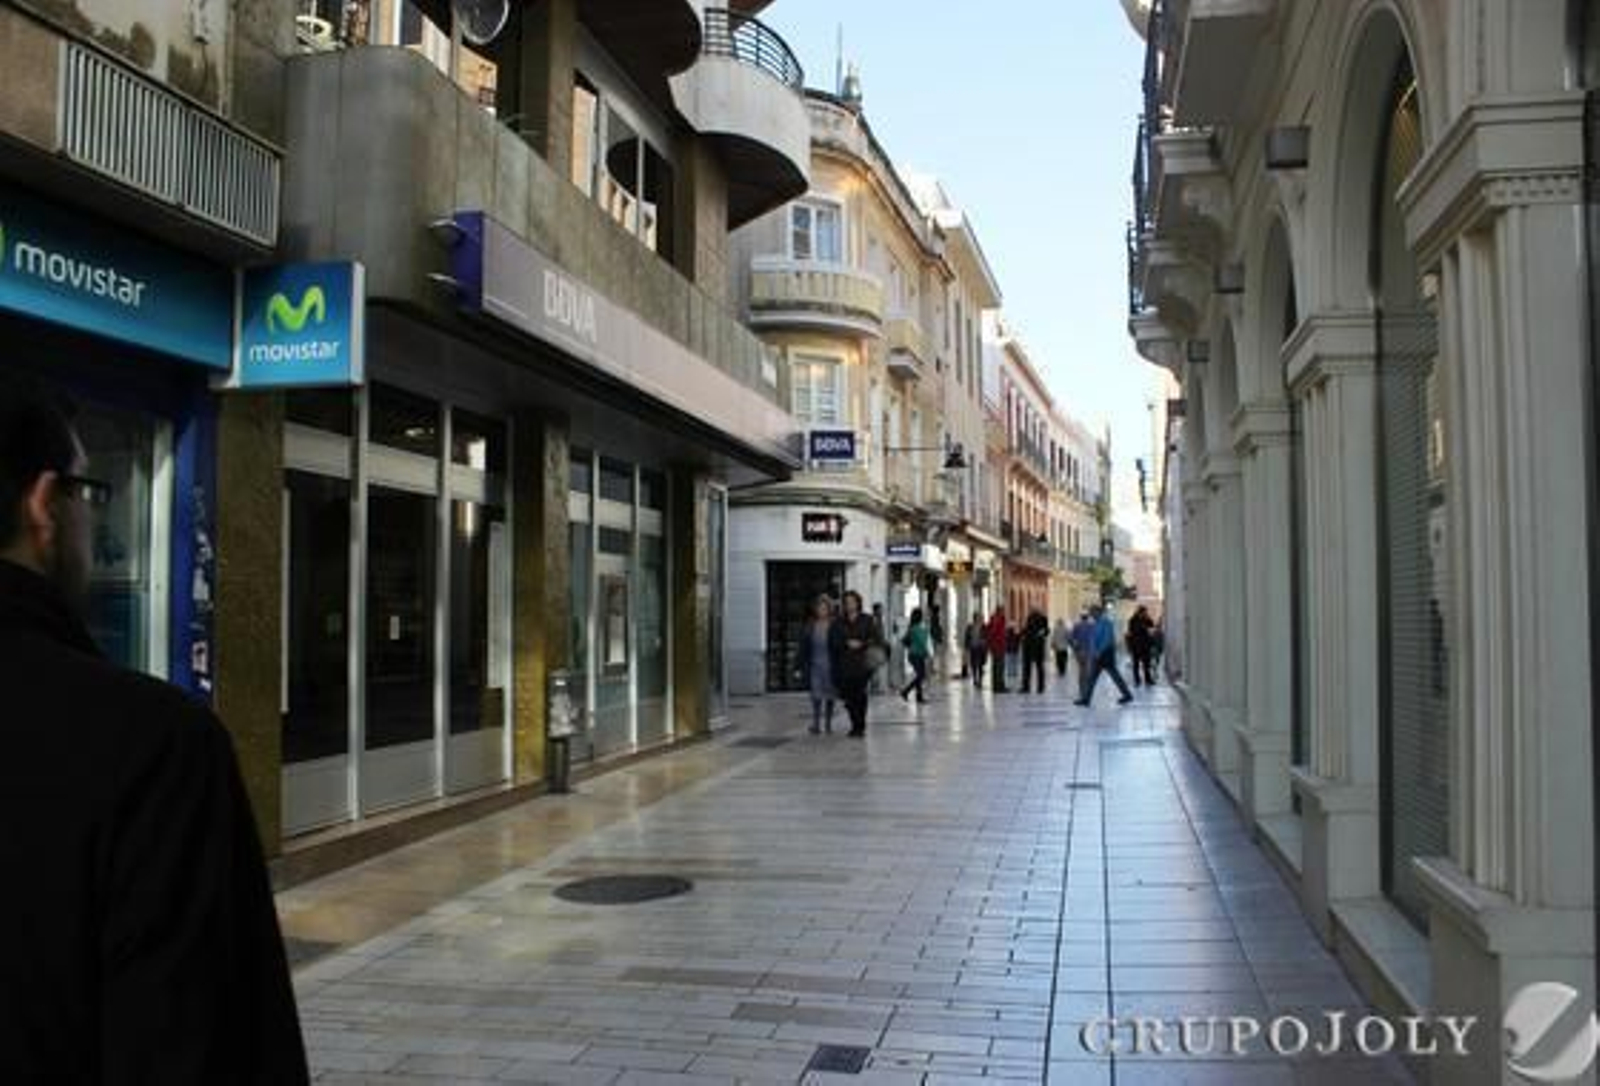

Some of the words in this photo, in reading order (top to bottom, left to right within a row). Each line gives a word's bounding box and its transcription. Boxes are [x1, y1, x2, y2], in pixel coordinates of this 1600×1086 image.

[14, 241, 146, 307] movistar
[543, 269, 598, 344] BBVA
[249, 339, 340, 362] movistar
[814, 437, 851, 451] BBVA
